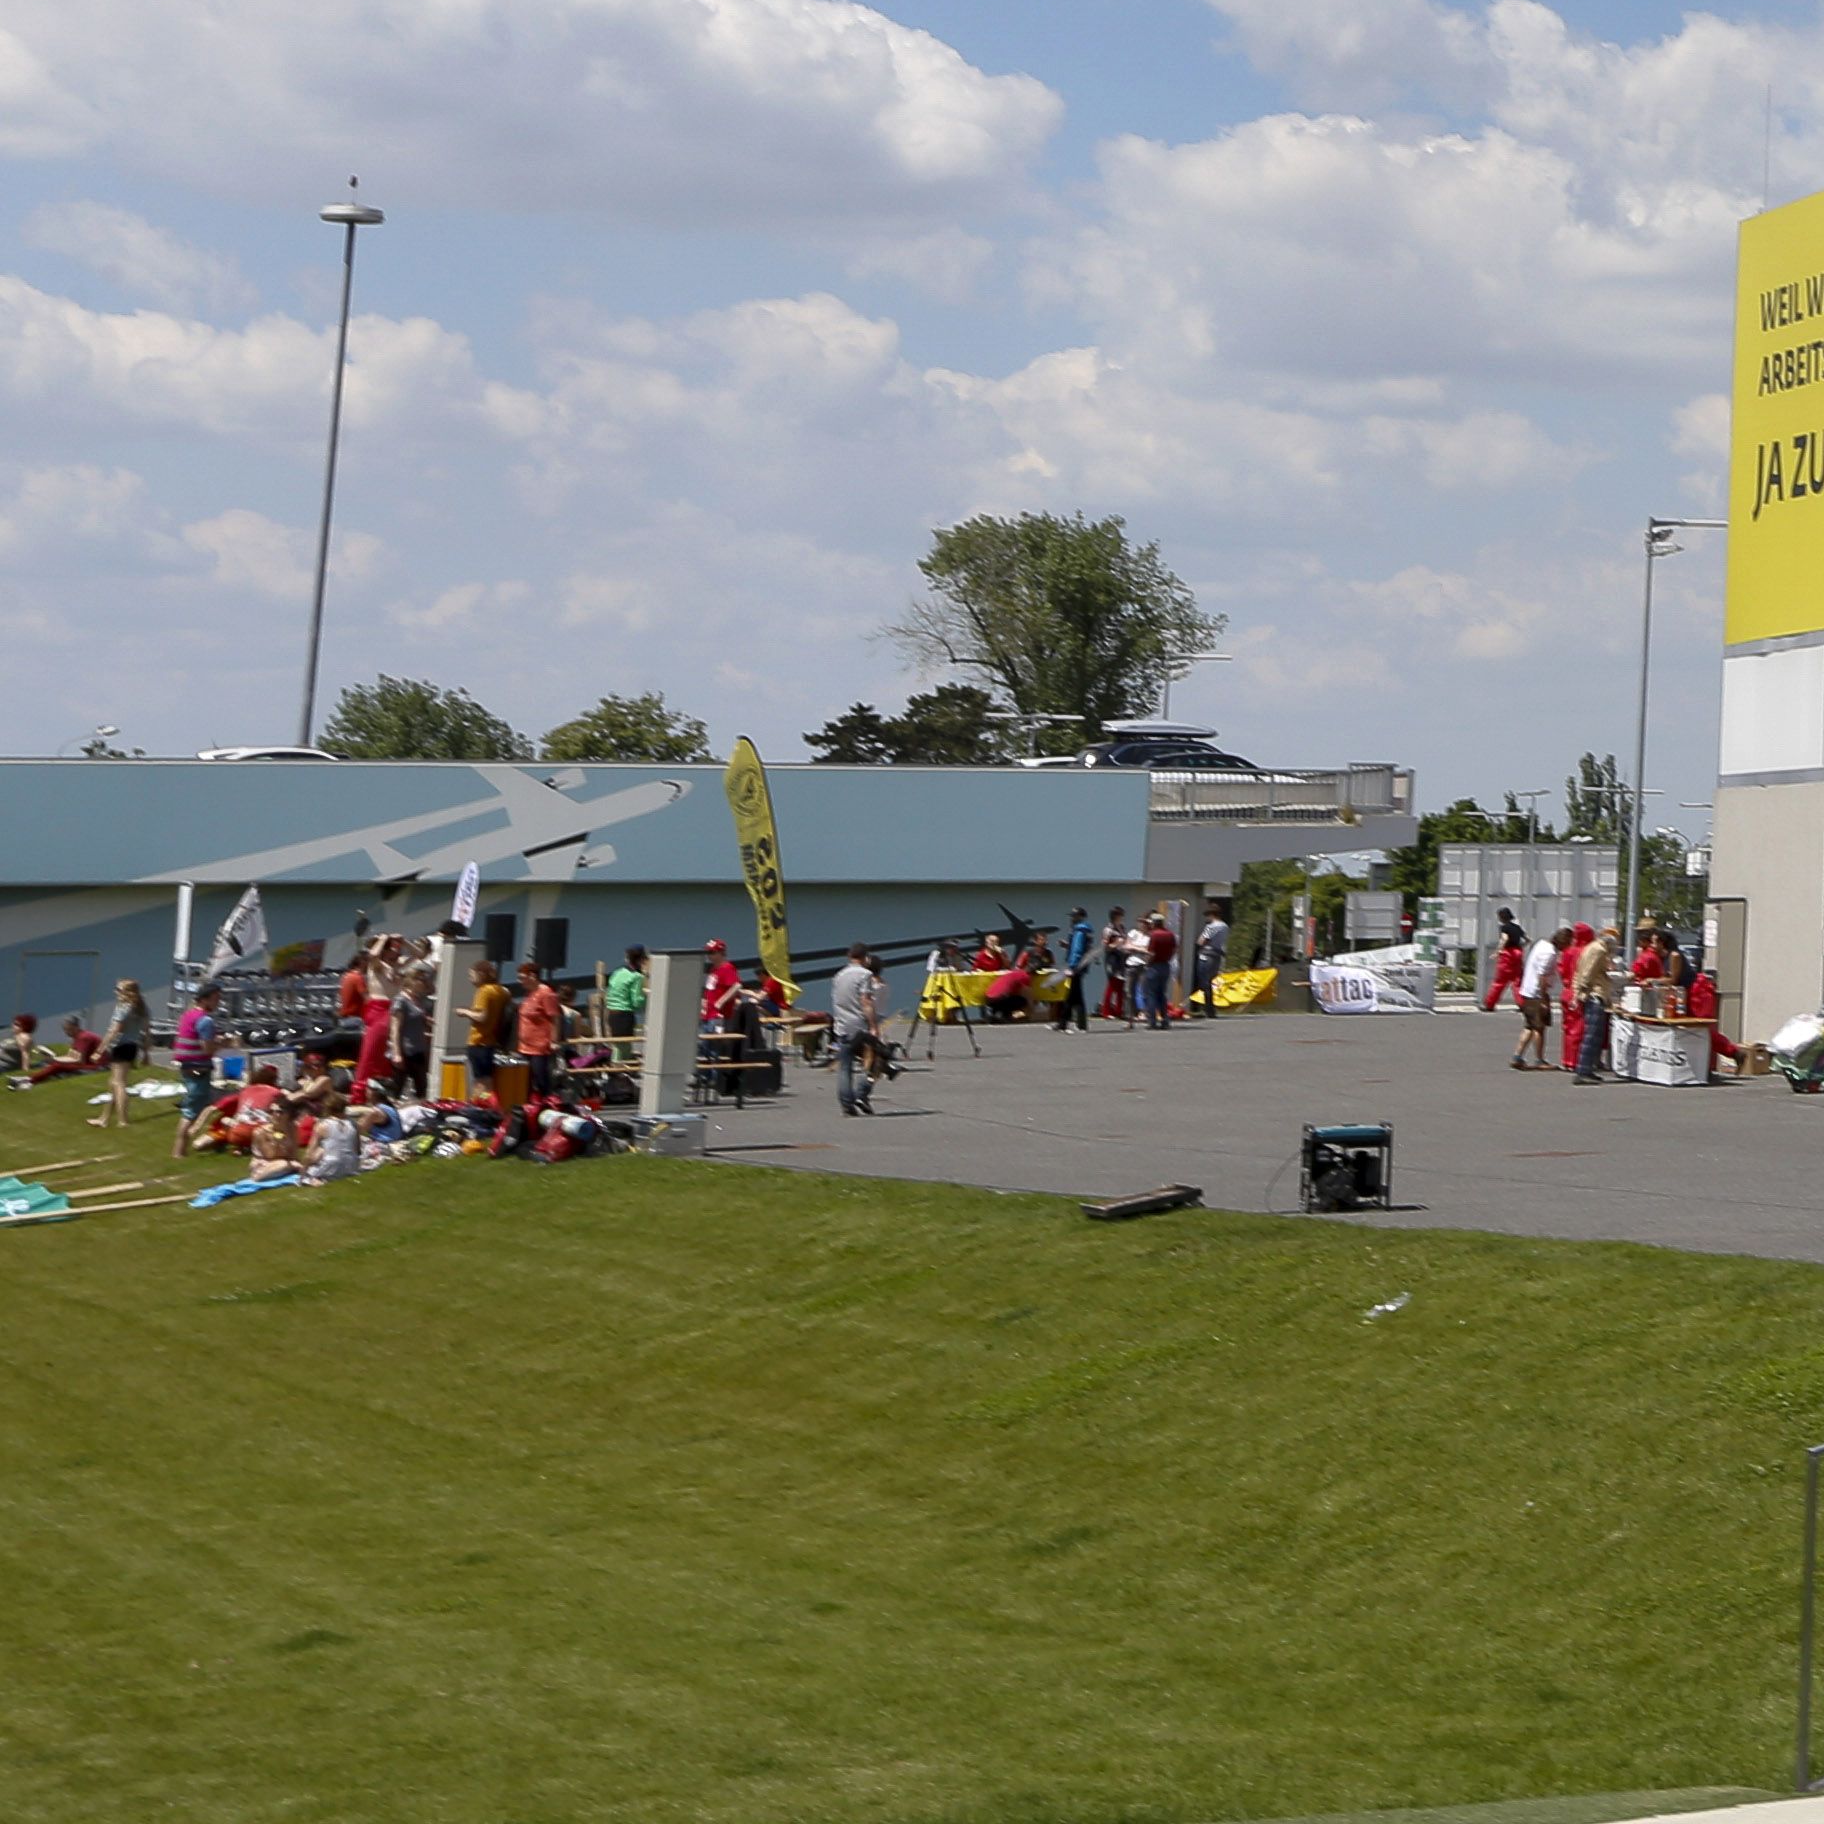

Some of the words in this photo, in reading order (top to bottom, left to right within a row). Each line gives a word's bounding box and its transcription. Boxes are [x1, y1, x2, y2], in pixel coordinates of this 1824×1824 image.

[1760, 282, 1804, 332] WEIL
[1751, 440, 1785, 522] JA
[1320, 975, 1375, 1003] attac
